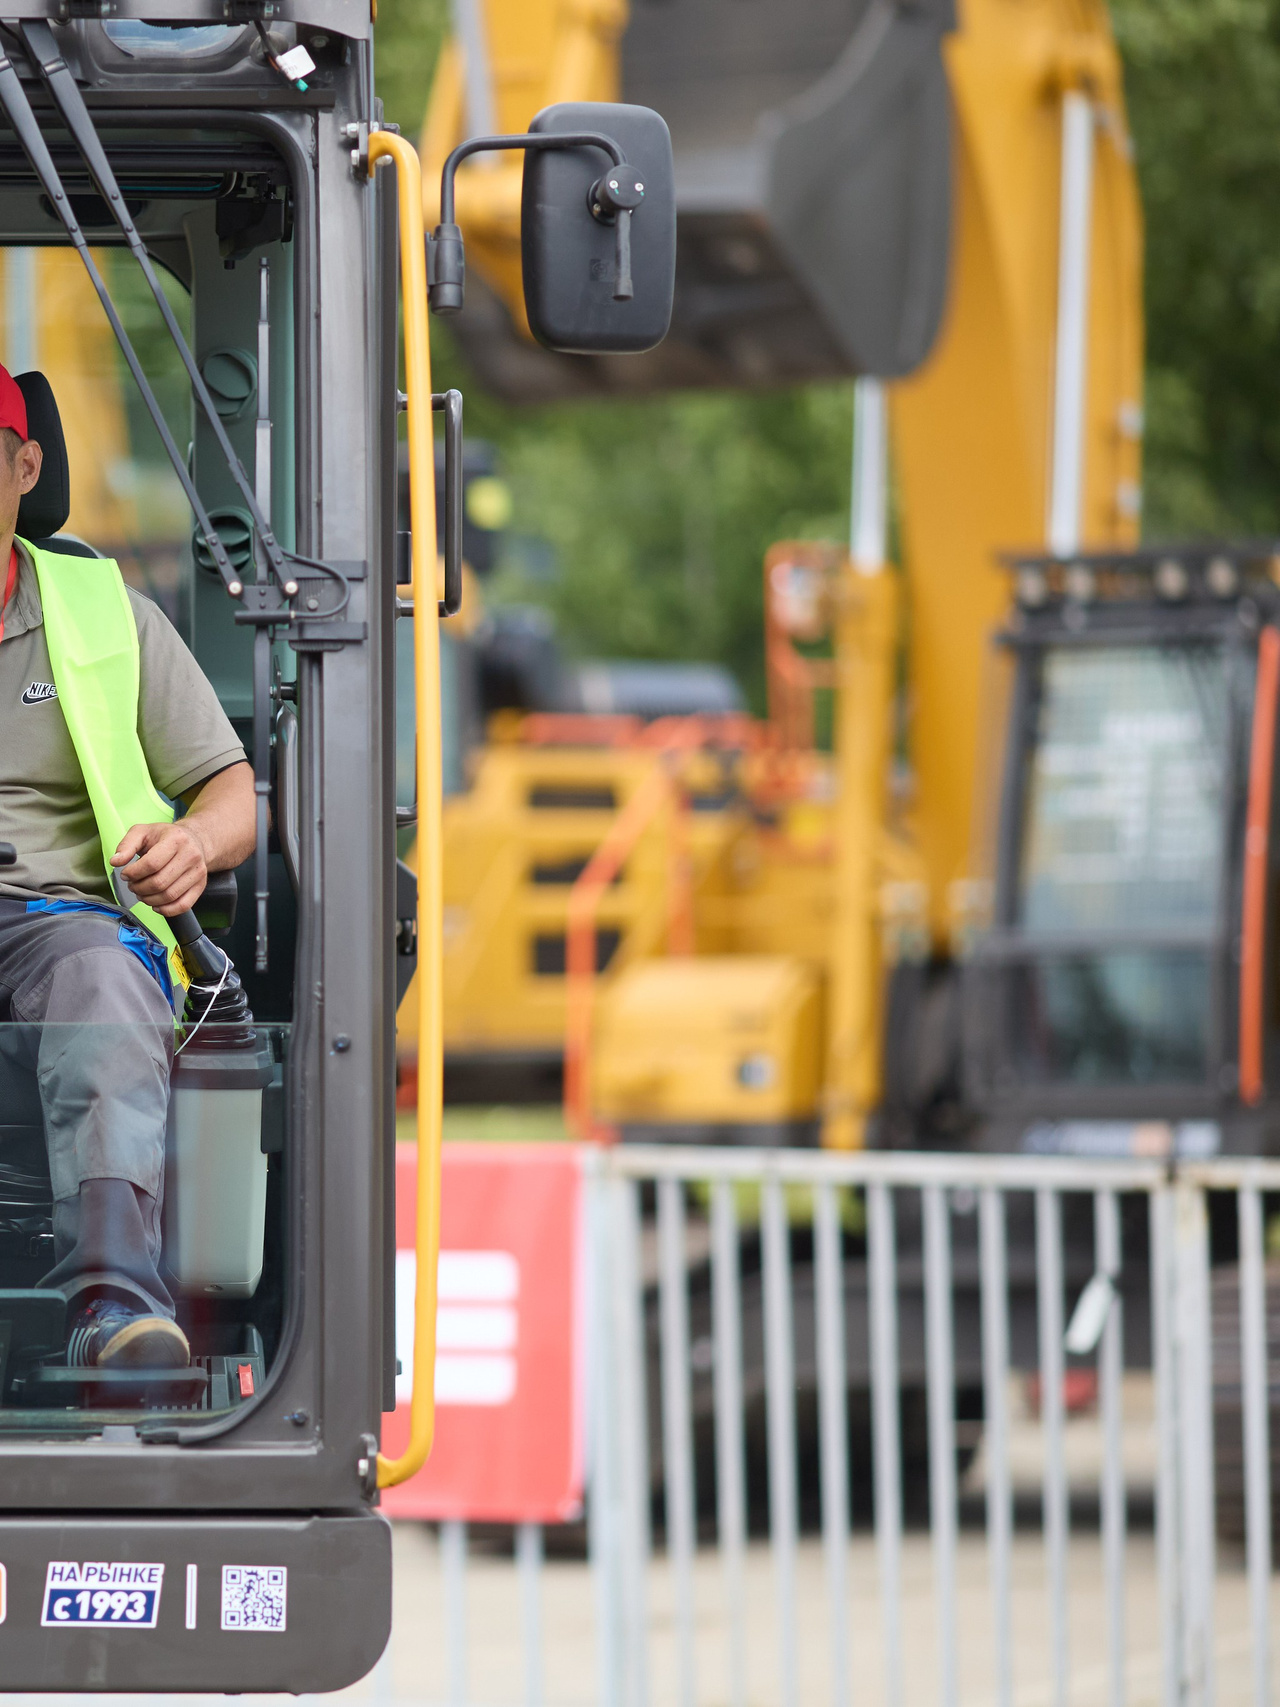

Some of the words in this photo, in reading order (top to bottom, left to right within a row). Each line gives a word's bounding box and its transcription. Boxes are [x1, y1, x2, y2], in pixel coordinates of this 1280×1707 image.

[28, 682, 57, 696] NIKE
[50, 1566, 78, 1582] НА
[84, 1566, 160, 1583] РЫНКЕ
[75, 1590, 147, 1620] 1993
